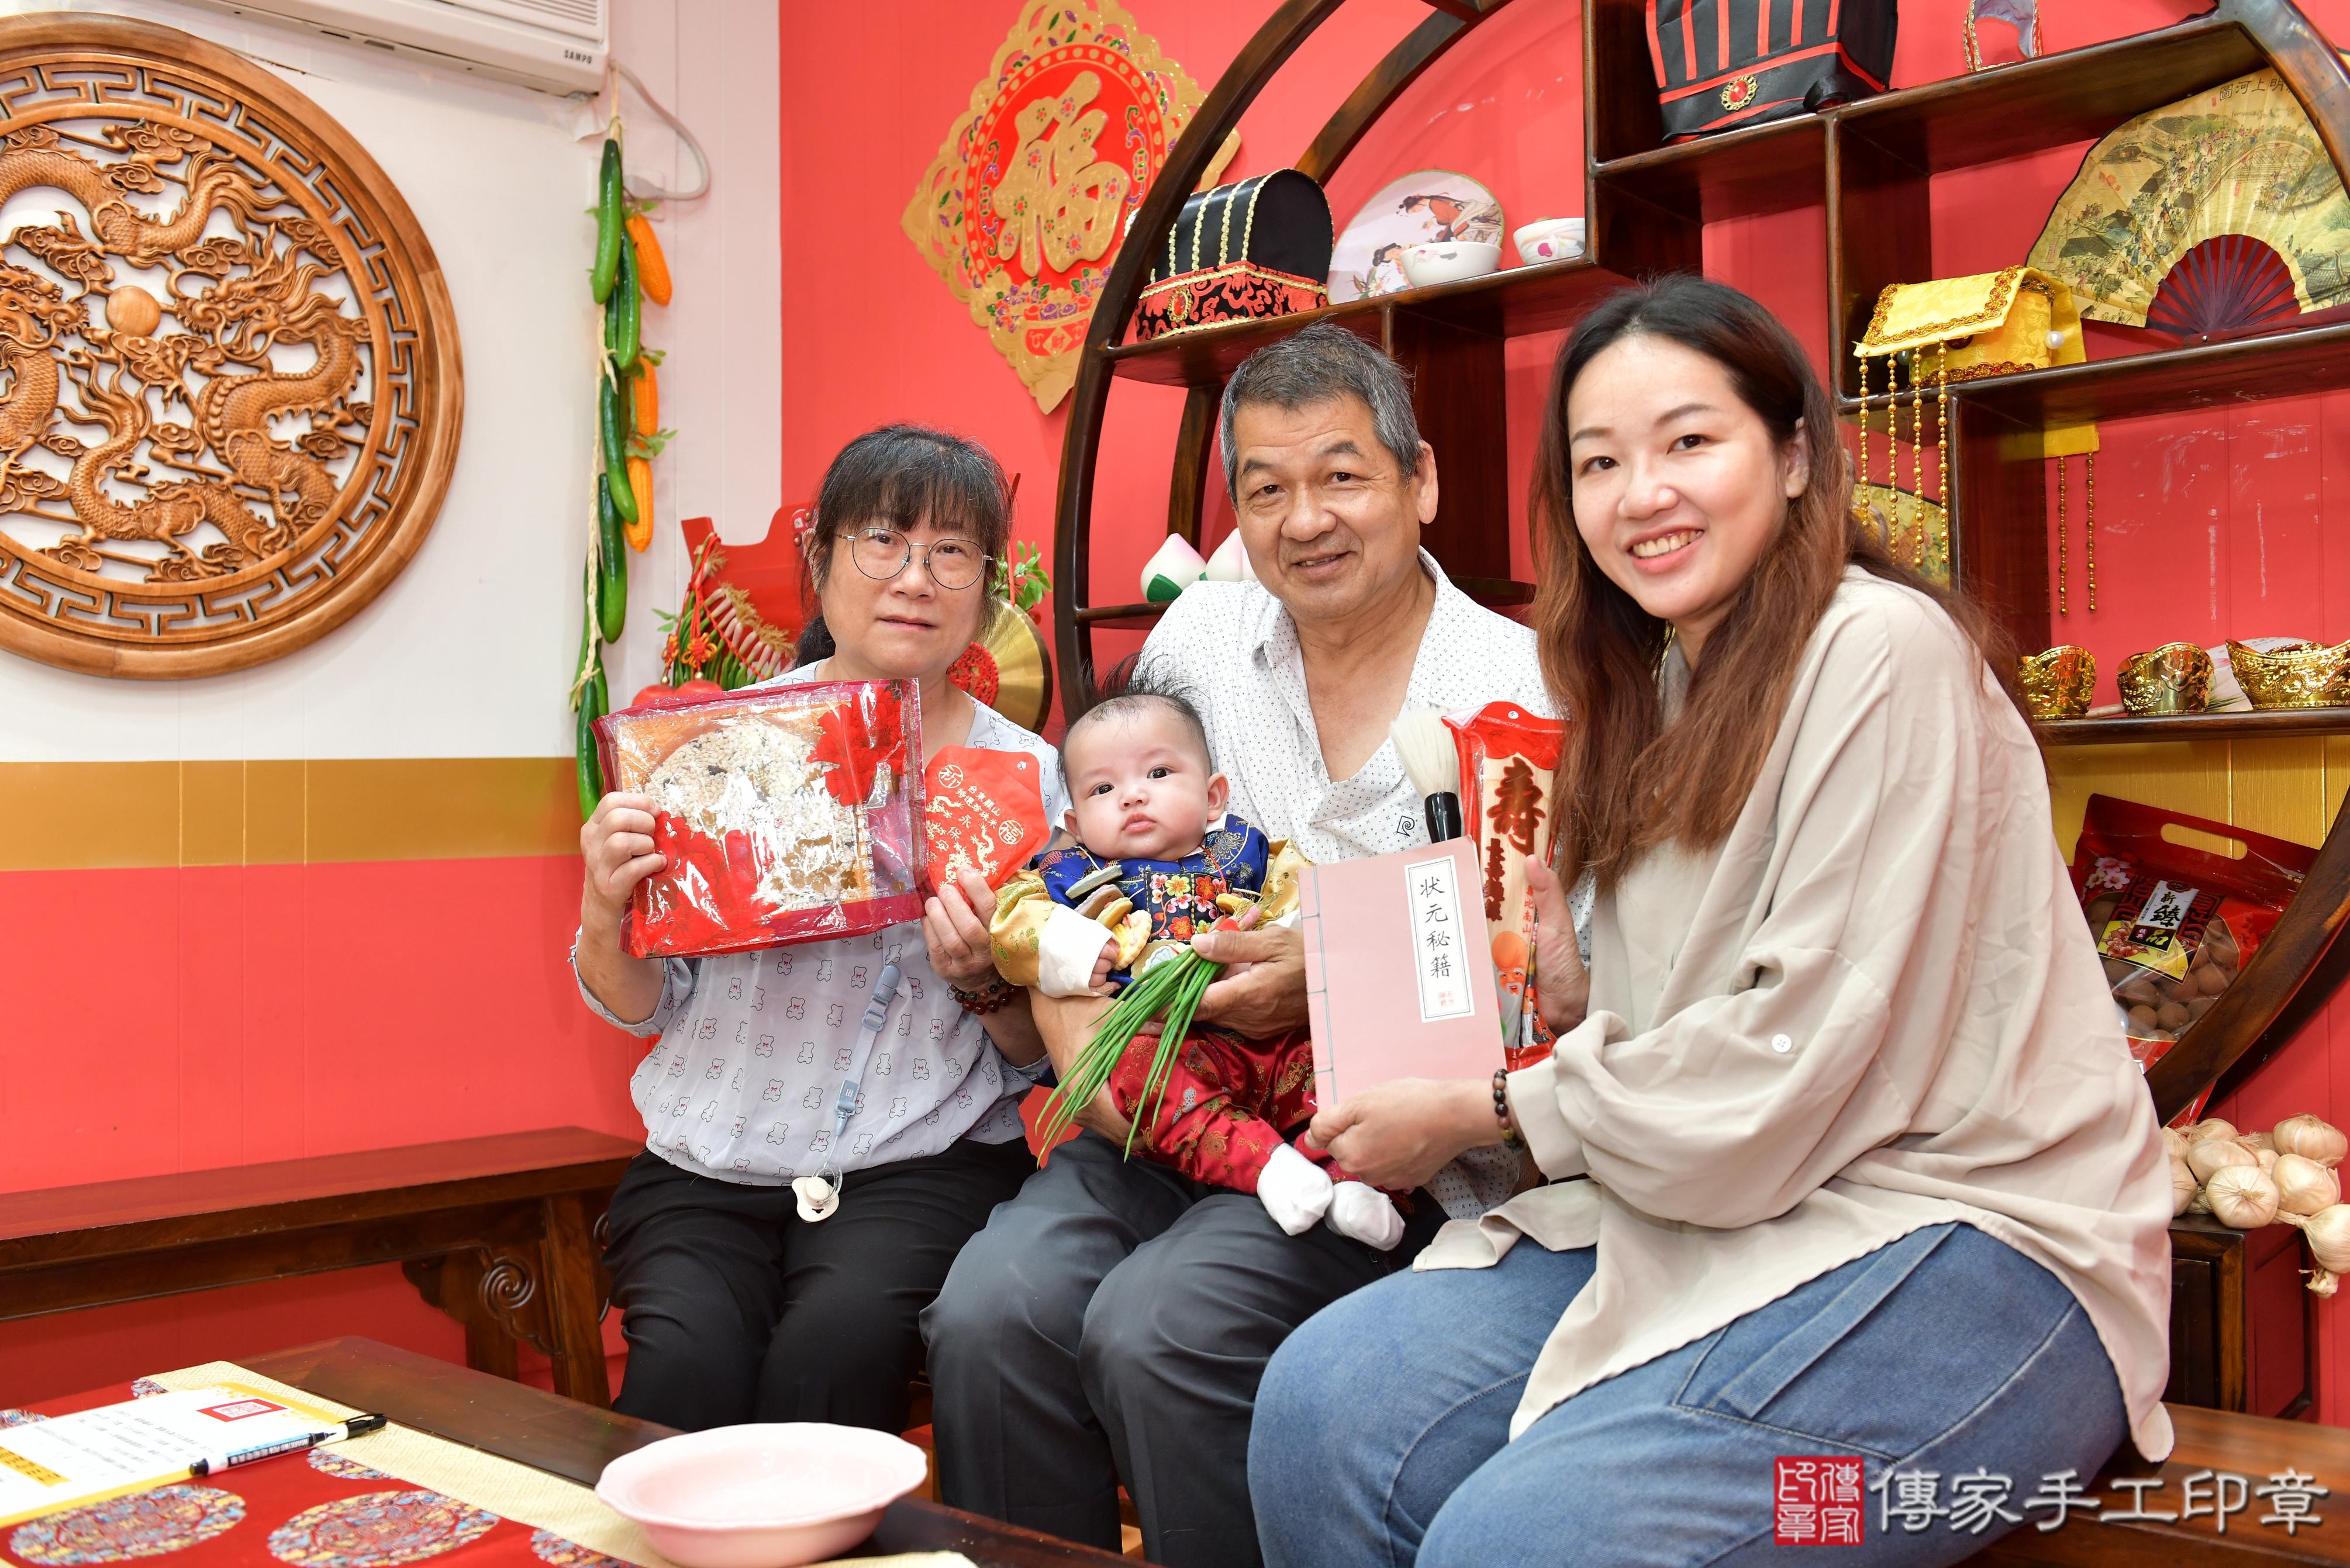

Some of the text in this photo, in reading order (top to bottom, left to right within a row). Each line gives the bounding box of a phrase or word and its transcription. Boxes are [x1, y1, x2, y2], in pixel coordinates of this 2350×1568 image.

[564, 49, 592, 64] SAMPO
[2220, 77, 2291, 101] 明上河圖
[992, 70, 1129, 277] 福
[938, 764, 964, 789] 祈
[955, 788, 998, 829] 特選珍珠米
[998, 820, 1024, 845] 福
